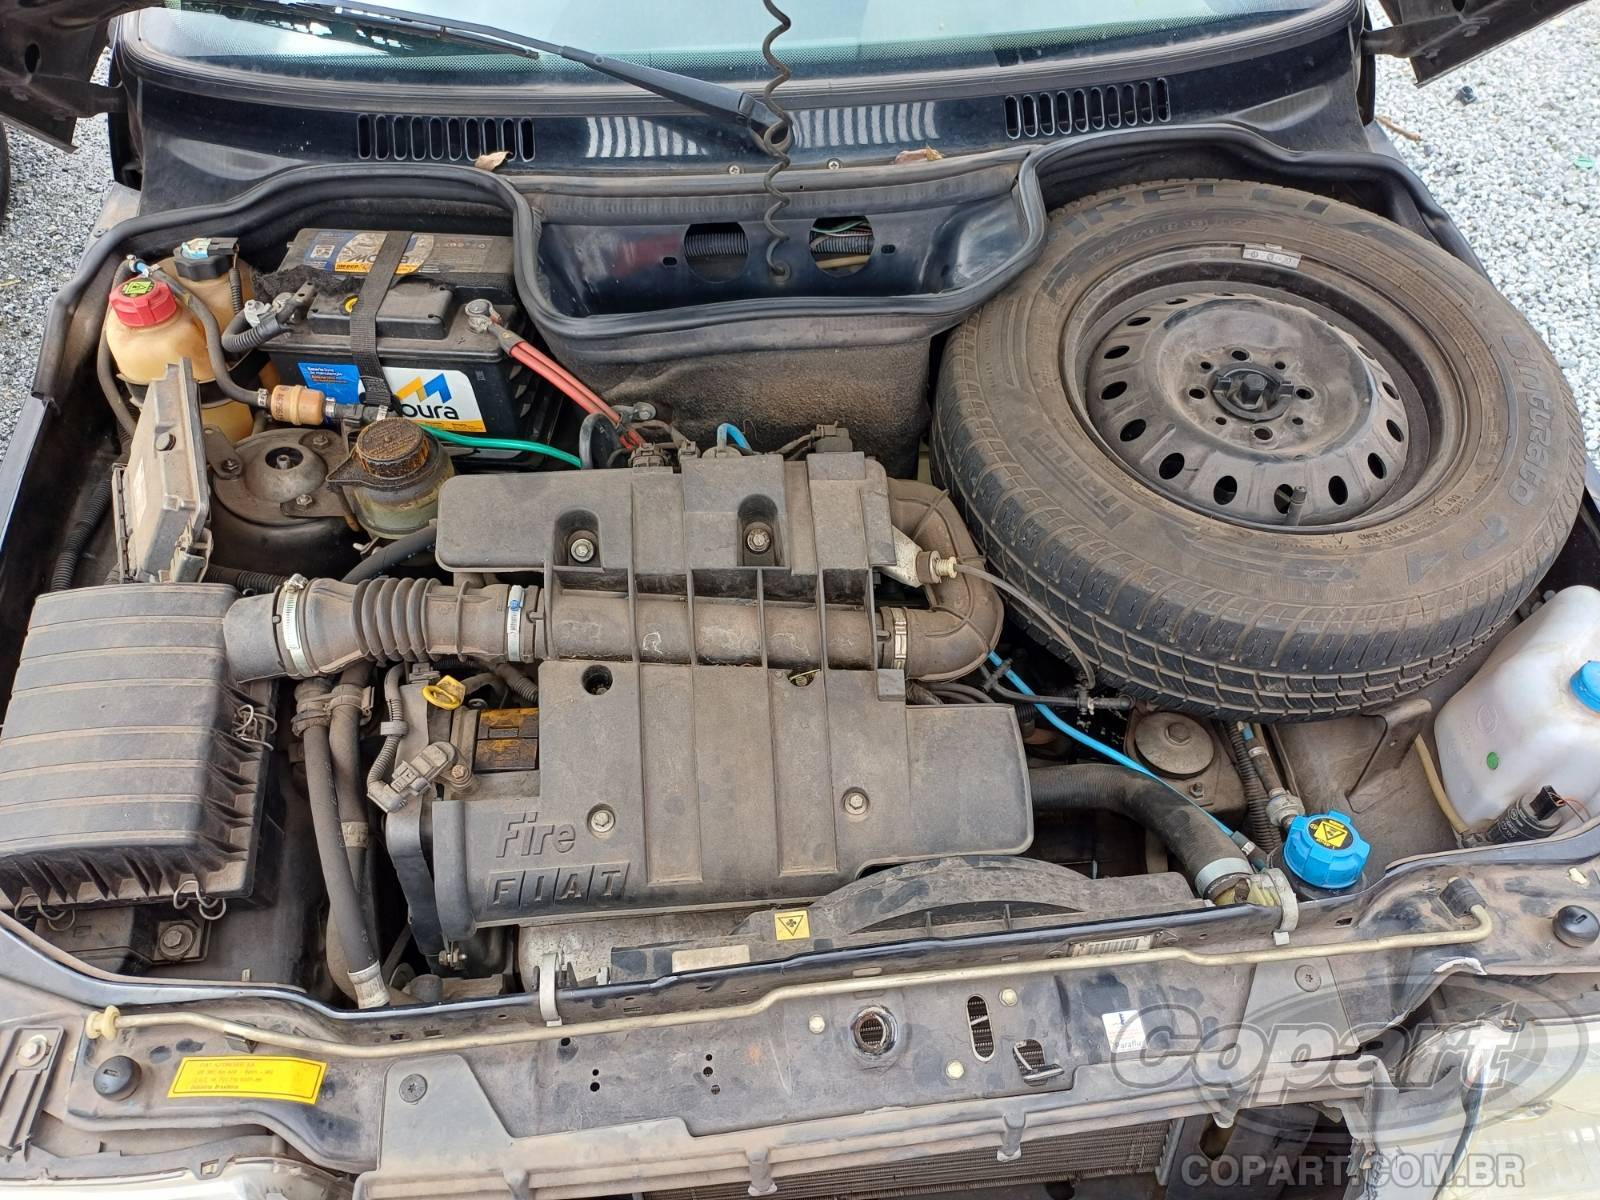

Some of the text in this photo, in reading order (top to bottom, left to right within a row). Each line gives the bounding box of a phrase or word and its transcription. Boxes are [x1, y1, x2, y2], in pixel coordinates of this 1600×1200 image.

[401, 403, 459, 420] oura
[496, 811, 576, 858] Fire
[492, 869, 622, 904] FIAT
